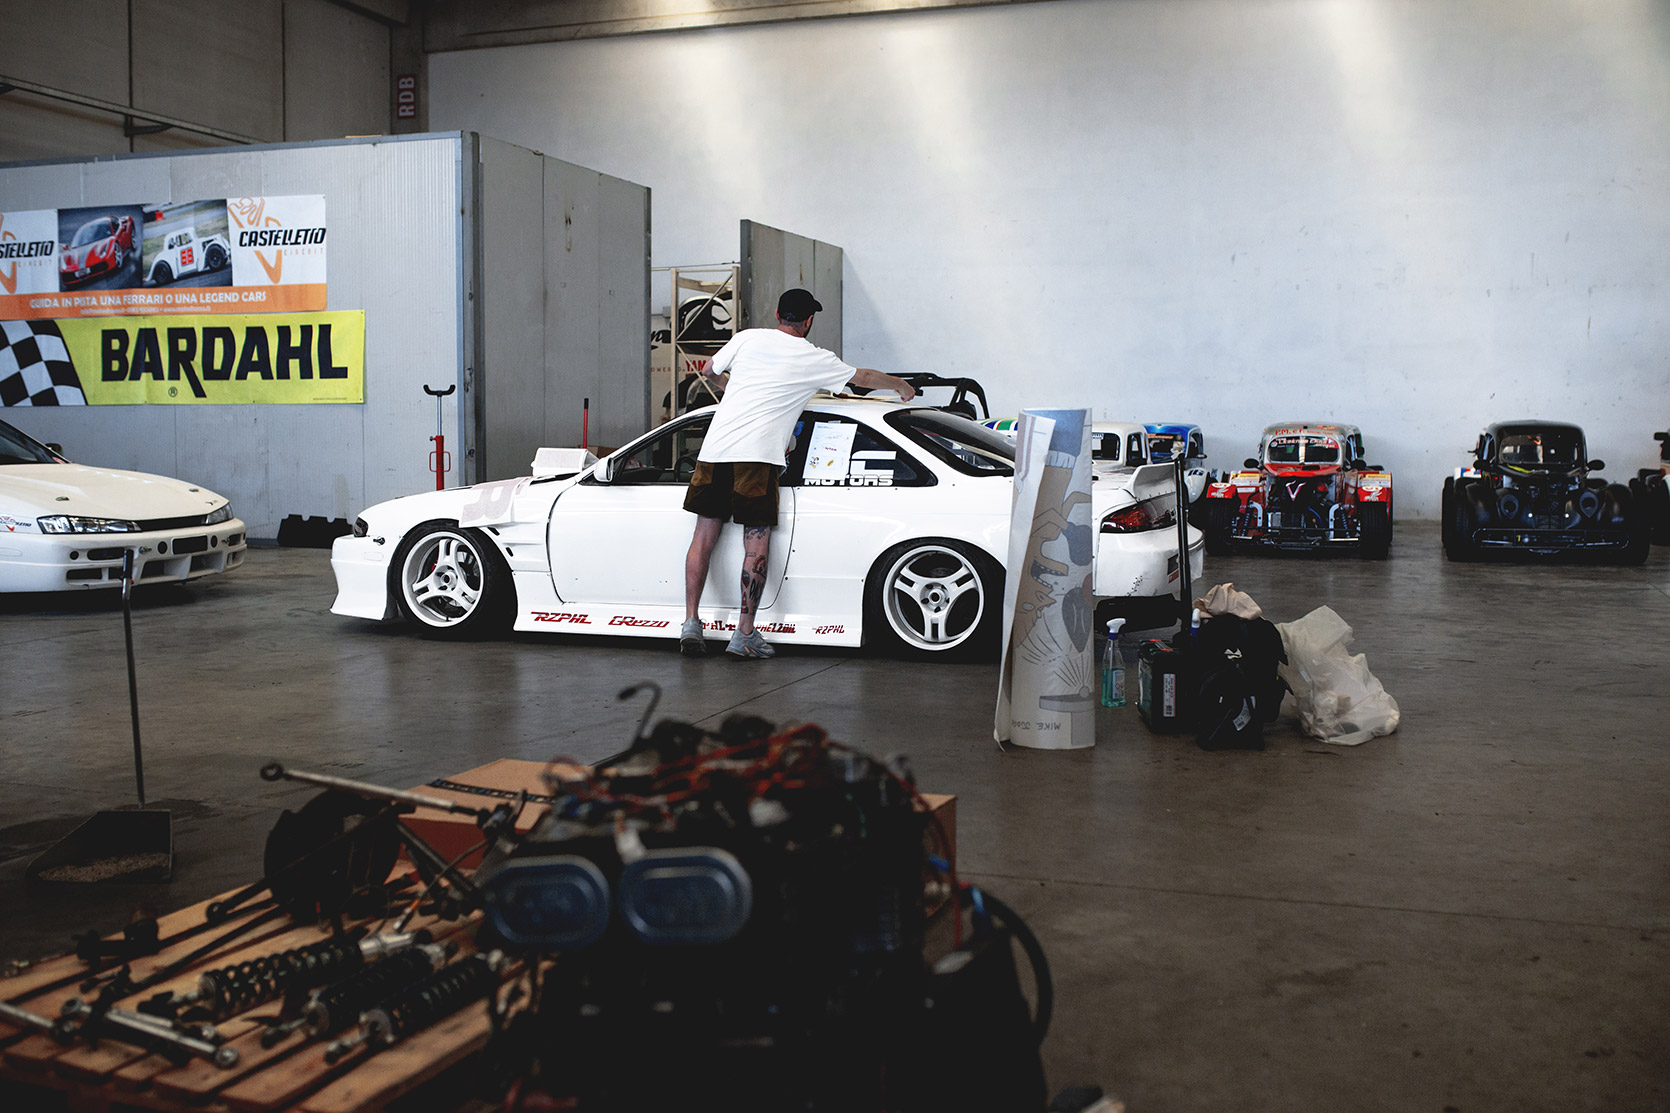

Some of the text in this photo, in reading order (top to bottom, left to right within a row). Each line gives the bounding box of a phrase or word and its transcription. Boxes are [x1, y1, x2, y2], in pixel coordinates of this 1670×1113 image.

[399, 77, 414, 116] RDB
[239, 227, 327, 247] CASTELLETTO
[30, 299, 60, 309] GUIDA
[62, 297, 72, 308] IN
[74, 296, 98, 307] PISTA
[100, 295, 121, 306] UNA
[123, 294, 163, 305] FERRARI
[175, 293, 198, 304] UNA
[200, 292, 239, 304] LEGEND
[241, 291, 266, 302] CARS
[101, 324, 348, 398] BARDAHL
[1036, 722, 1061, 730] MIKE
